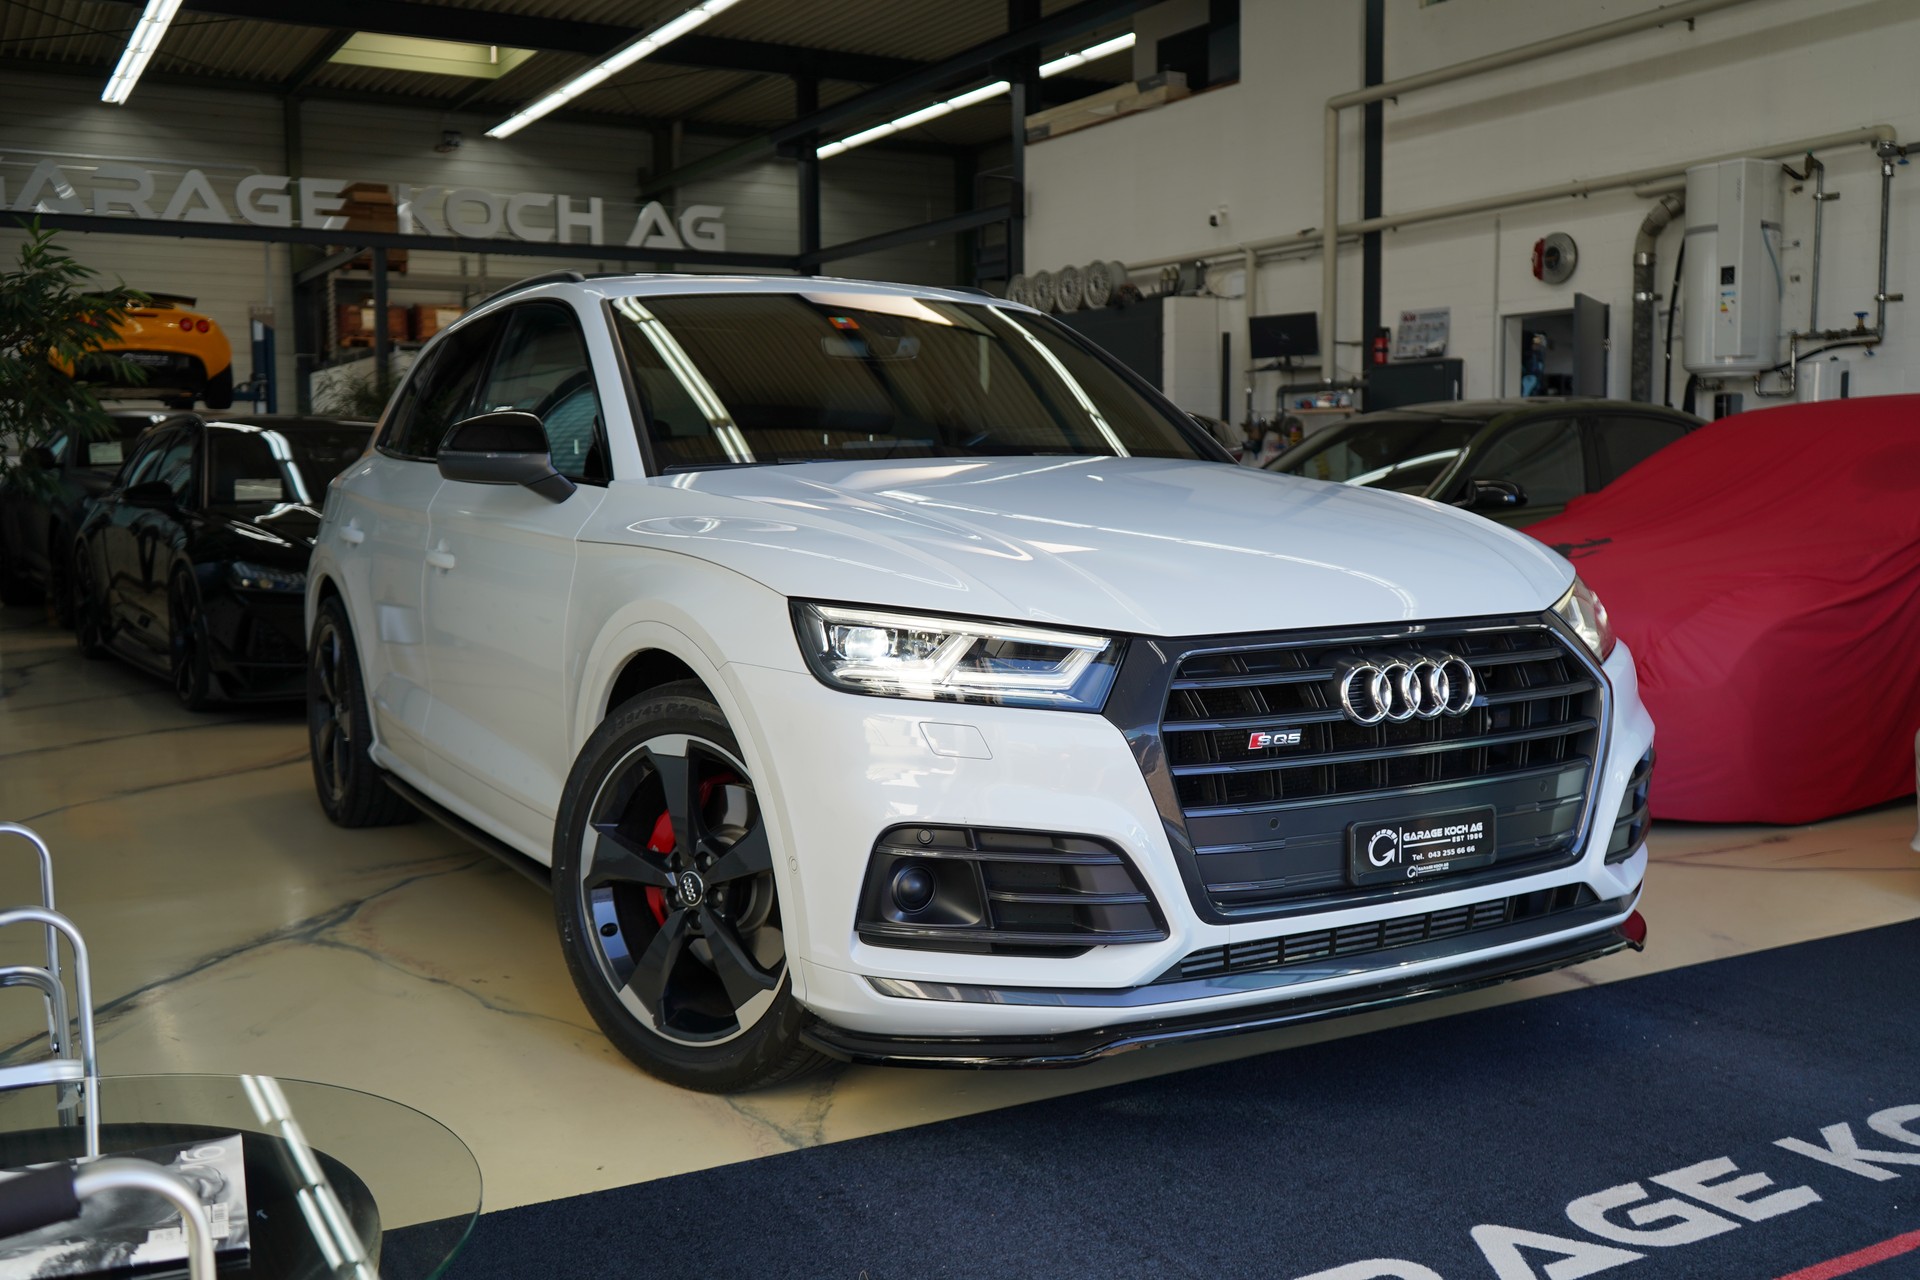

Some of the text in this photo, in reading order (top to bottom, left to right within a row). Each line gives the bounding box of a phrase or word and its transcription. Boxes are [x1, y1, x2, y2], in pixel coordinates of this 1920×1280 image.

[0, 156, 726, 251] ARAGE KOCH AG
[1256, 733, 1301, 746] SQ5
[1403, 822, 1483, 841] GARAGE KOCH AG
[1412, 845, 1475, 861] Tel. 043 255 66 66
[1290, 1156, 1823, 1280] AGE
